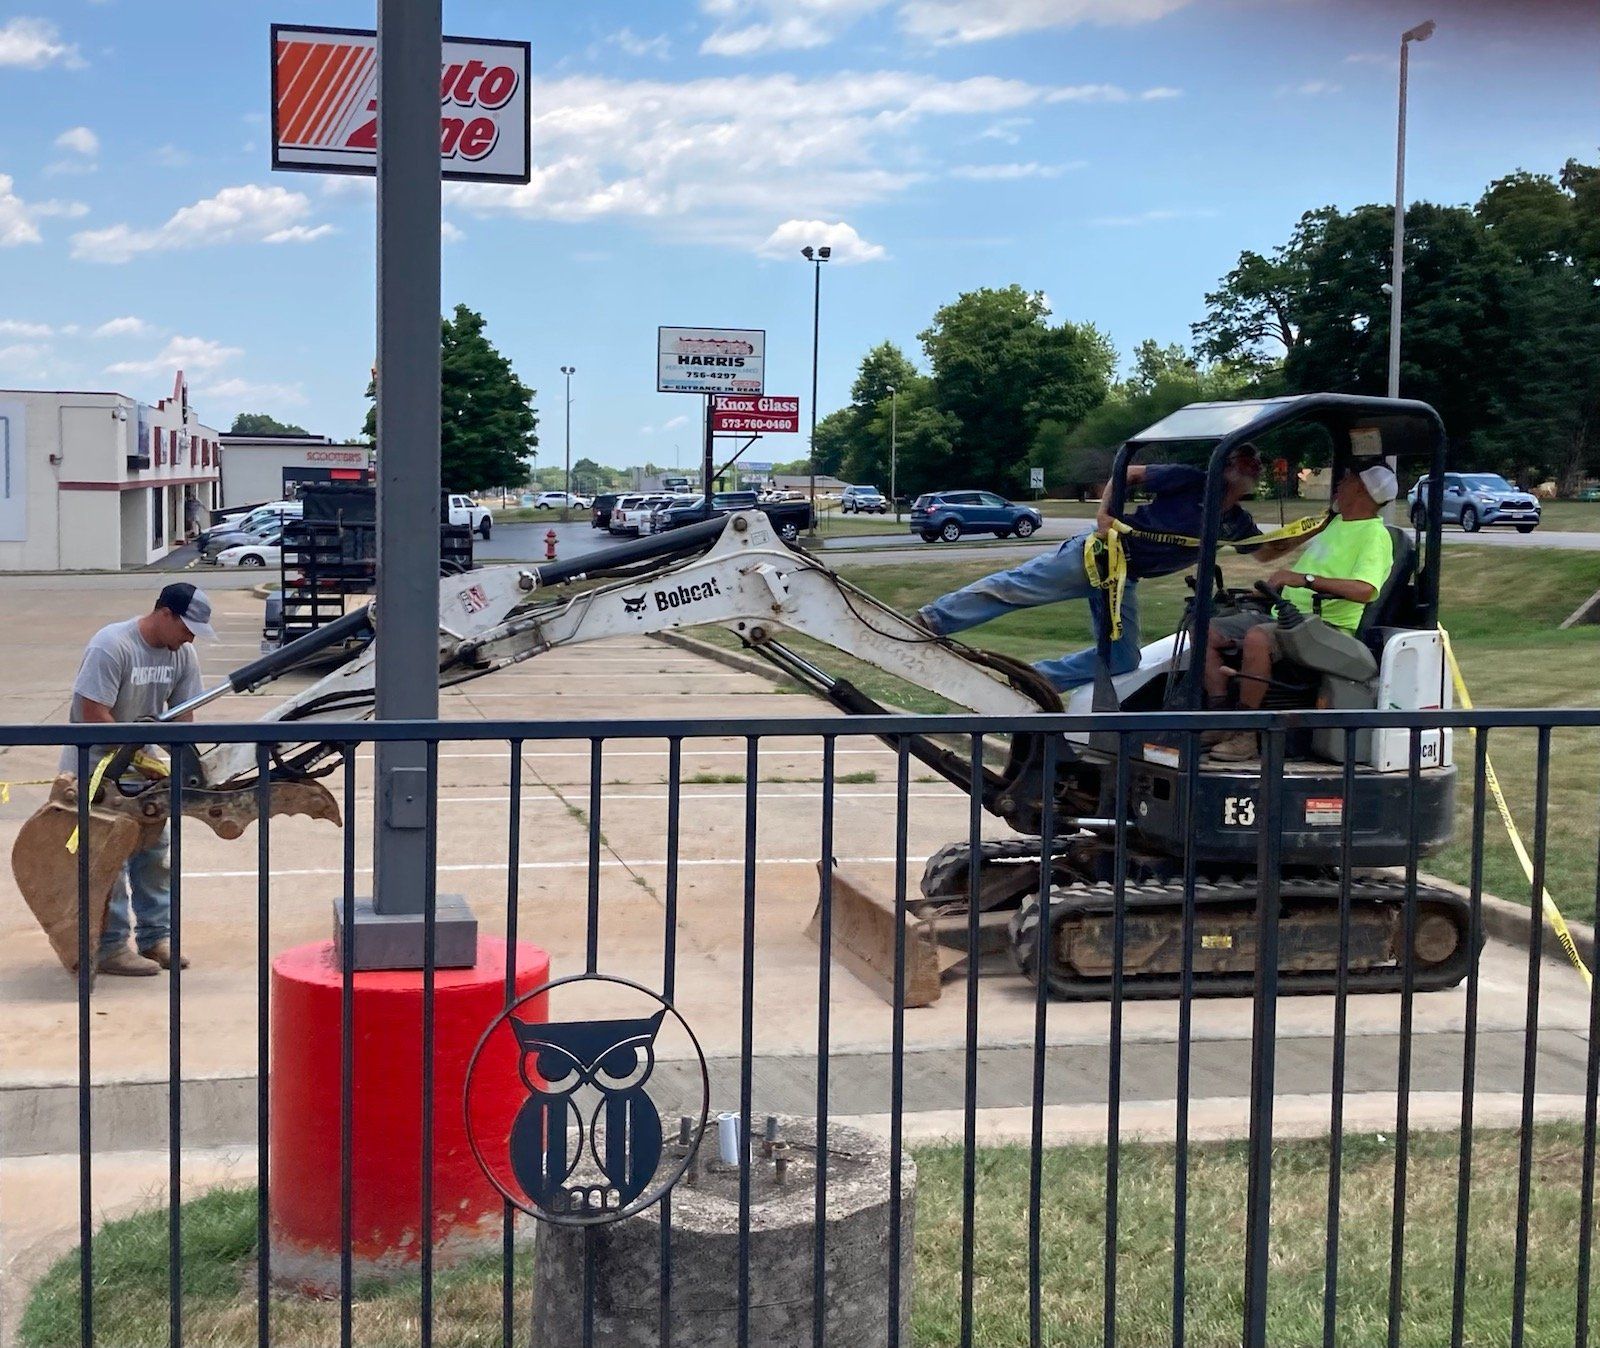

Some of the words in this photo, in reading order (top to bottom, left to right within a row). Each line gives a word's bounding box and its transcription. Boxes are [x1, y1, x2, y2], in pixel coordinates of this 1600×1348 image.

[440, 60, 518, 106] uto
[678, 355, 745, 367] HARRIS
[715, 397, 755, 411] Knox
[757, 398, 798, 412] Glass
[654, 576, 721, 612] Bobcat
